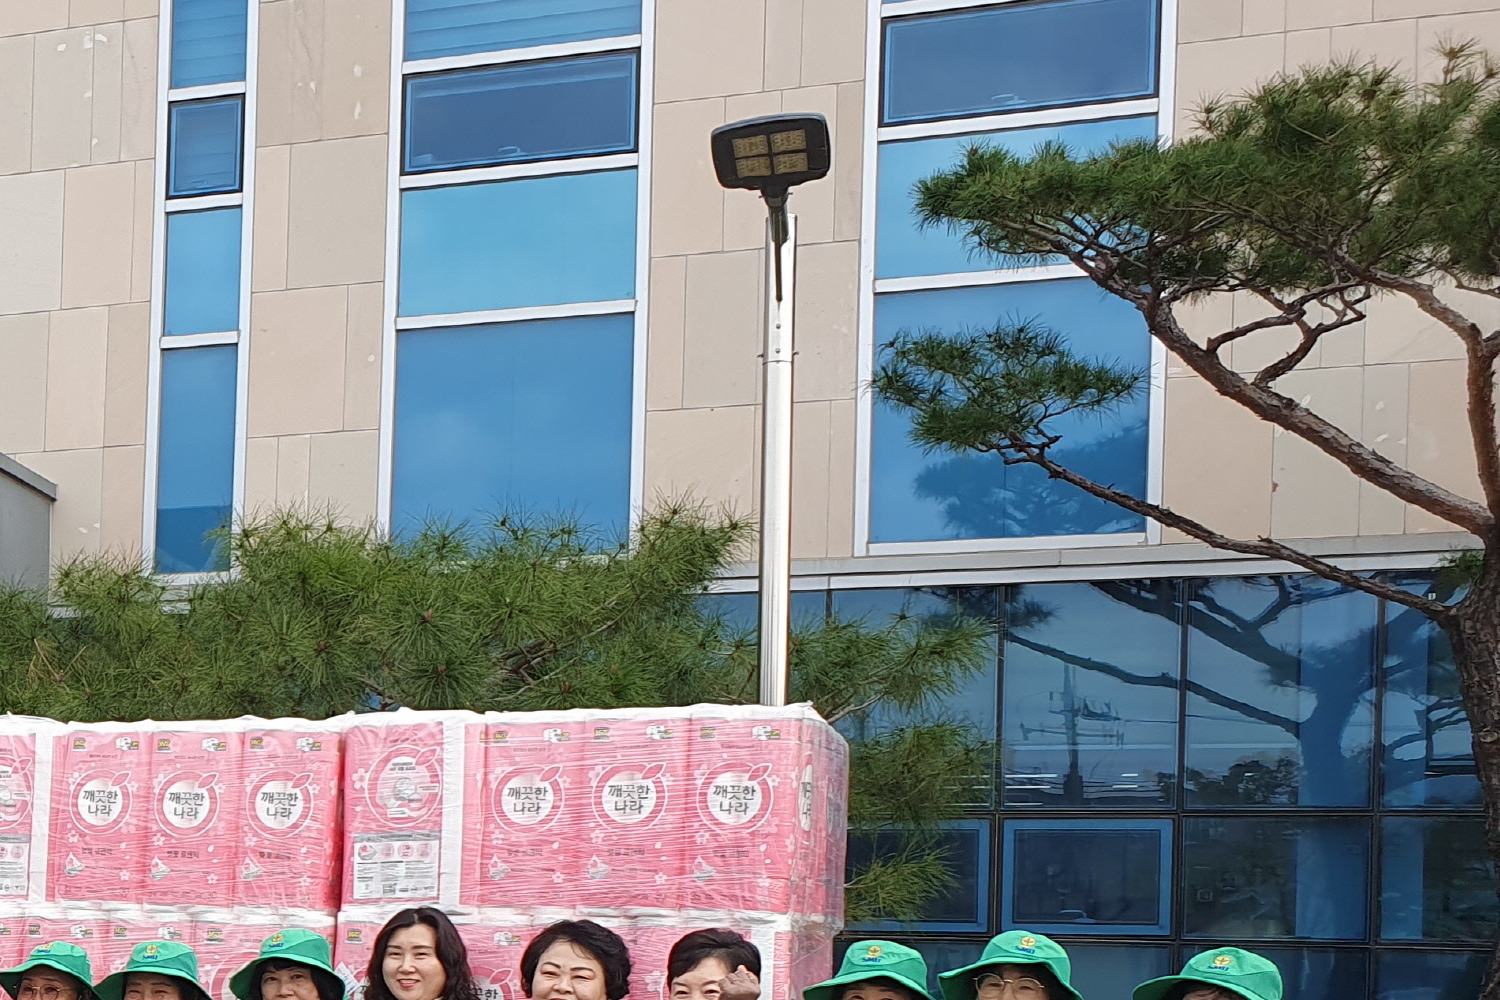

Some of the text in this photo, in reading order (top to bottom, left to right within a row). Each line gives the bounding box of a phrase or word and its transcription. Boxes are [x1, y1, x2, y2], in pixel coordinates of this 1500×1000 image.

[83, 790, 118, 804] 깨끗한
[168, 792, 205, 806] 깨끗한
[260, 792, 298, 807] 깨끗한
[506, 786, 549, 801] 깨끗한
[608, 785, 651, 800] 깨끗한
[712, 785, 757, 801] 깨끗한
[88, 804, 112, 817] 나라
[174, 807, 199, 819] 나라
[266, 807, 292, 820] 나라
[513, 802, 541, 815] 나라
[614, 800, 642, 814] 나라
[719, 801, 749, 815] 나라
